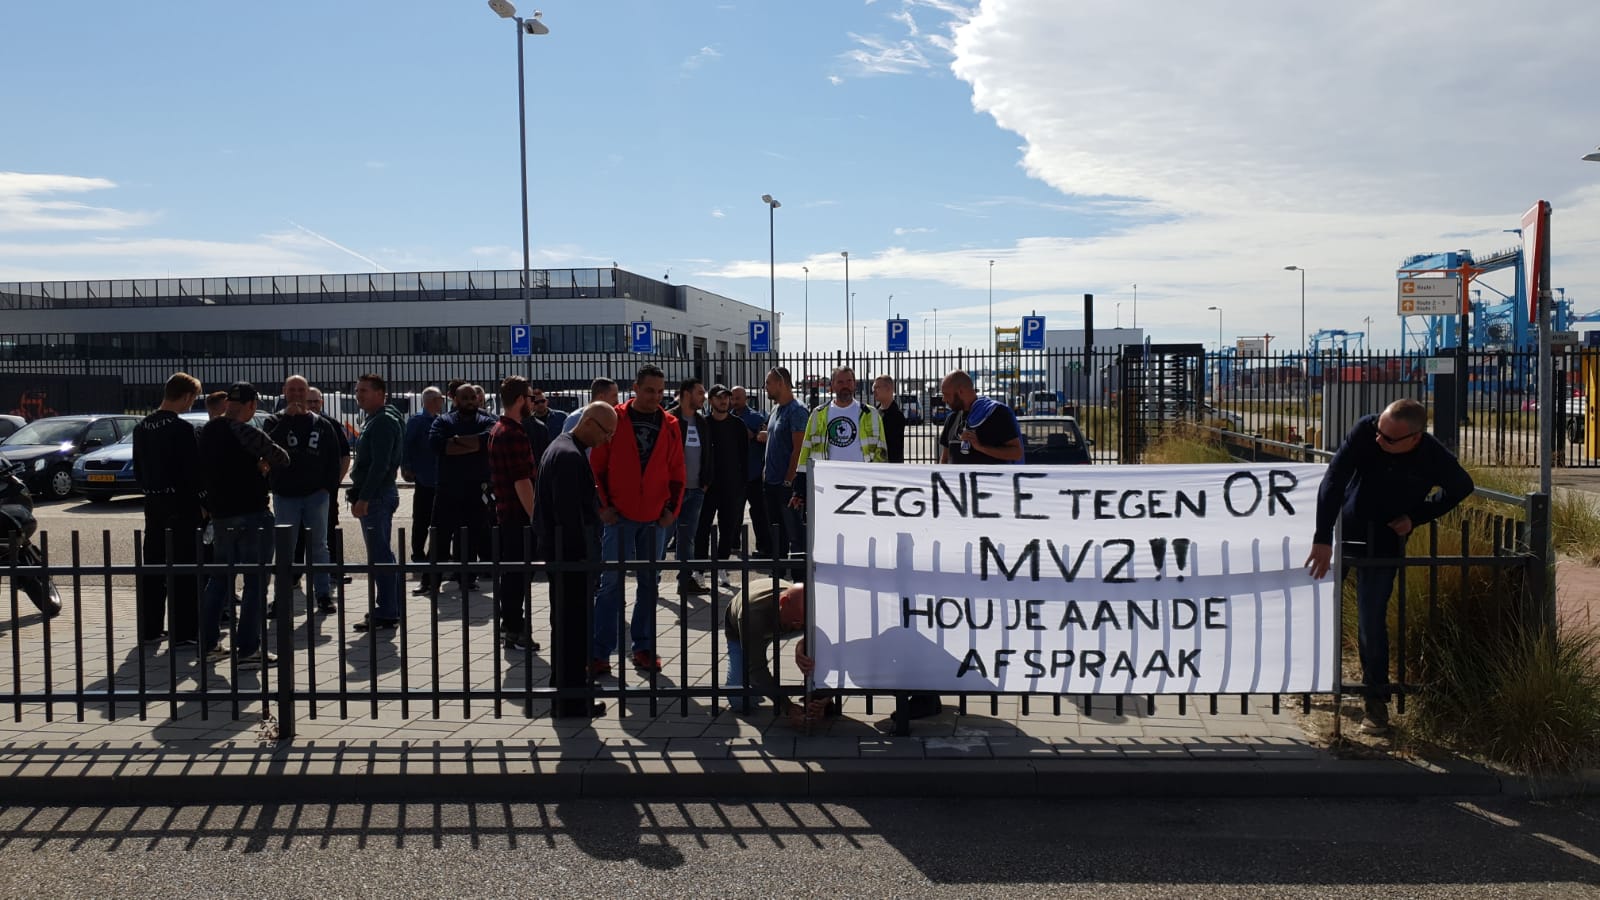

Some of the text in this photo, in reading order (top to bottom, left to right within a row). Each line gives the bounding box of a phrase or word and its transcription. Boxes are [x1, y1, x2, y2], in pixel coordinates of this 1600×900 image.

[515, 327, 526, 343] P
[636, 324, 648, 341] P
[753, 324, 765, 340] P
[892, 323, 904, 339] P
[1027, 319, 1040, 337] P
[287, 430, 320, 449] 6 2
[1059, 489, 1206, 520] TEGEN
[1223, 469, 1299, 517] OR
[956, 648, 1202, 680] AFSPRAAK
